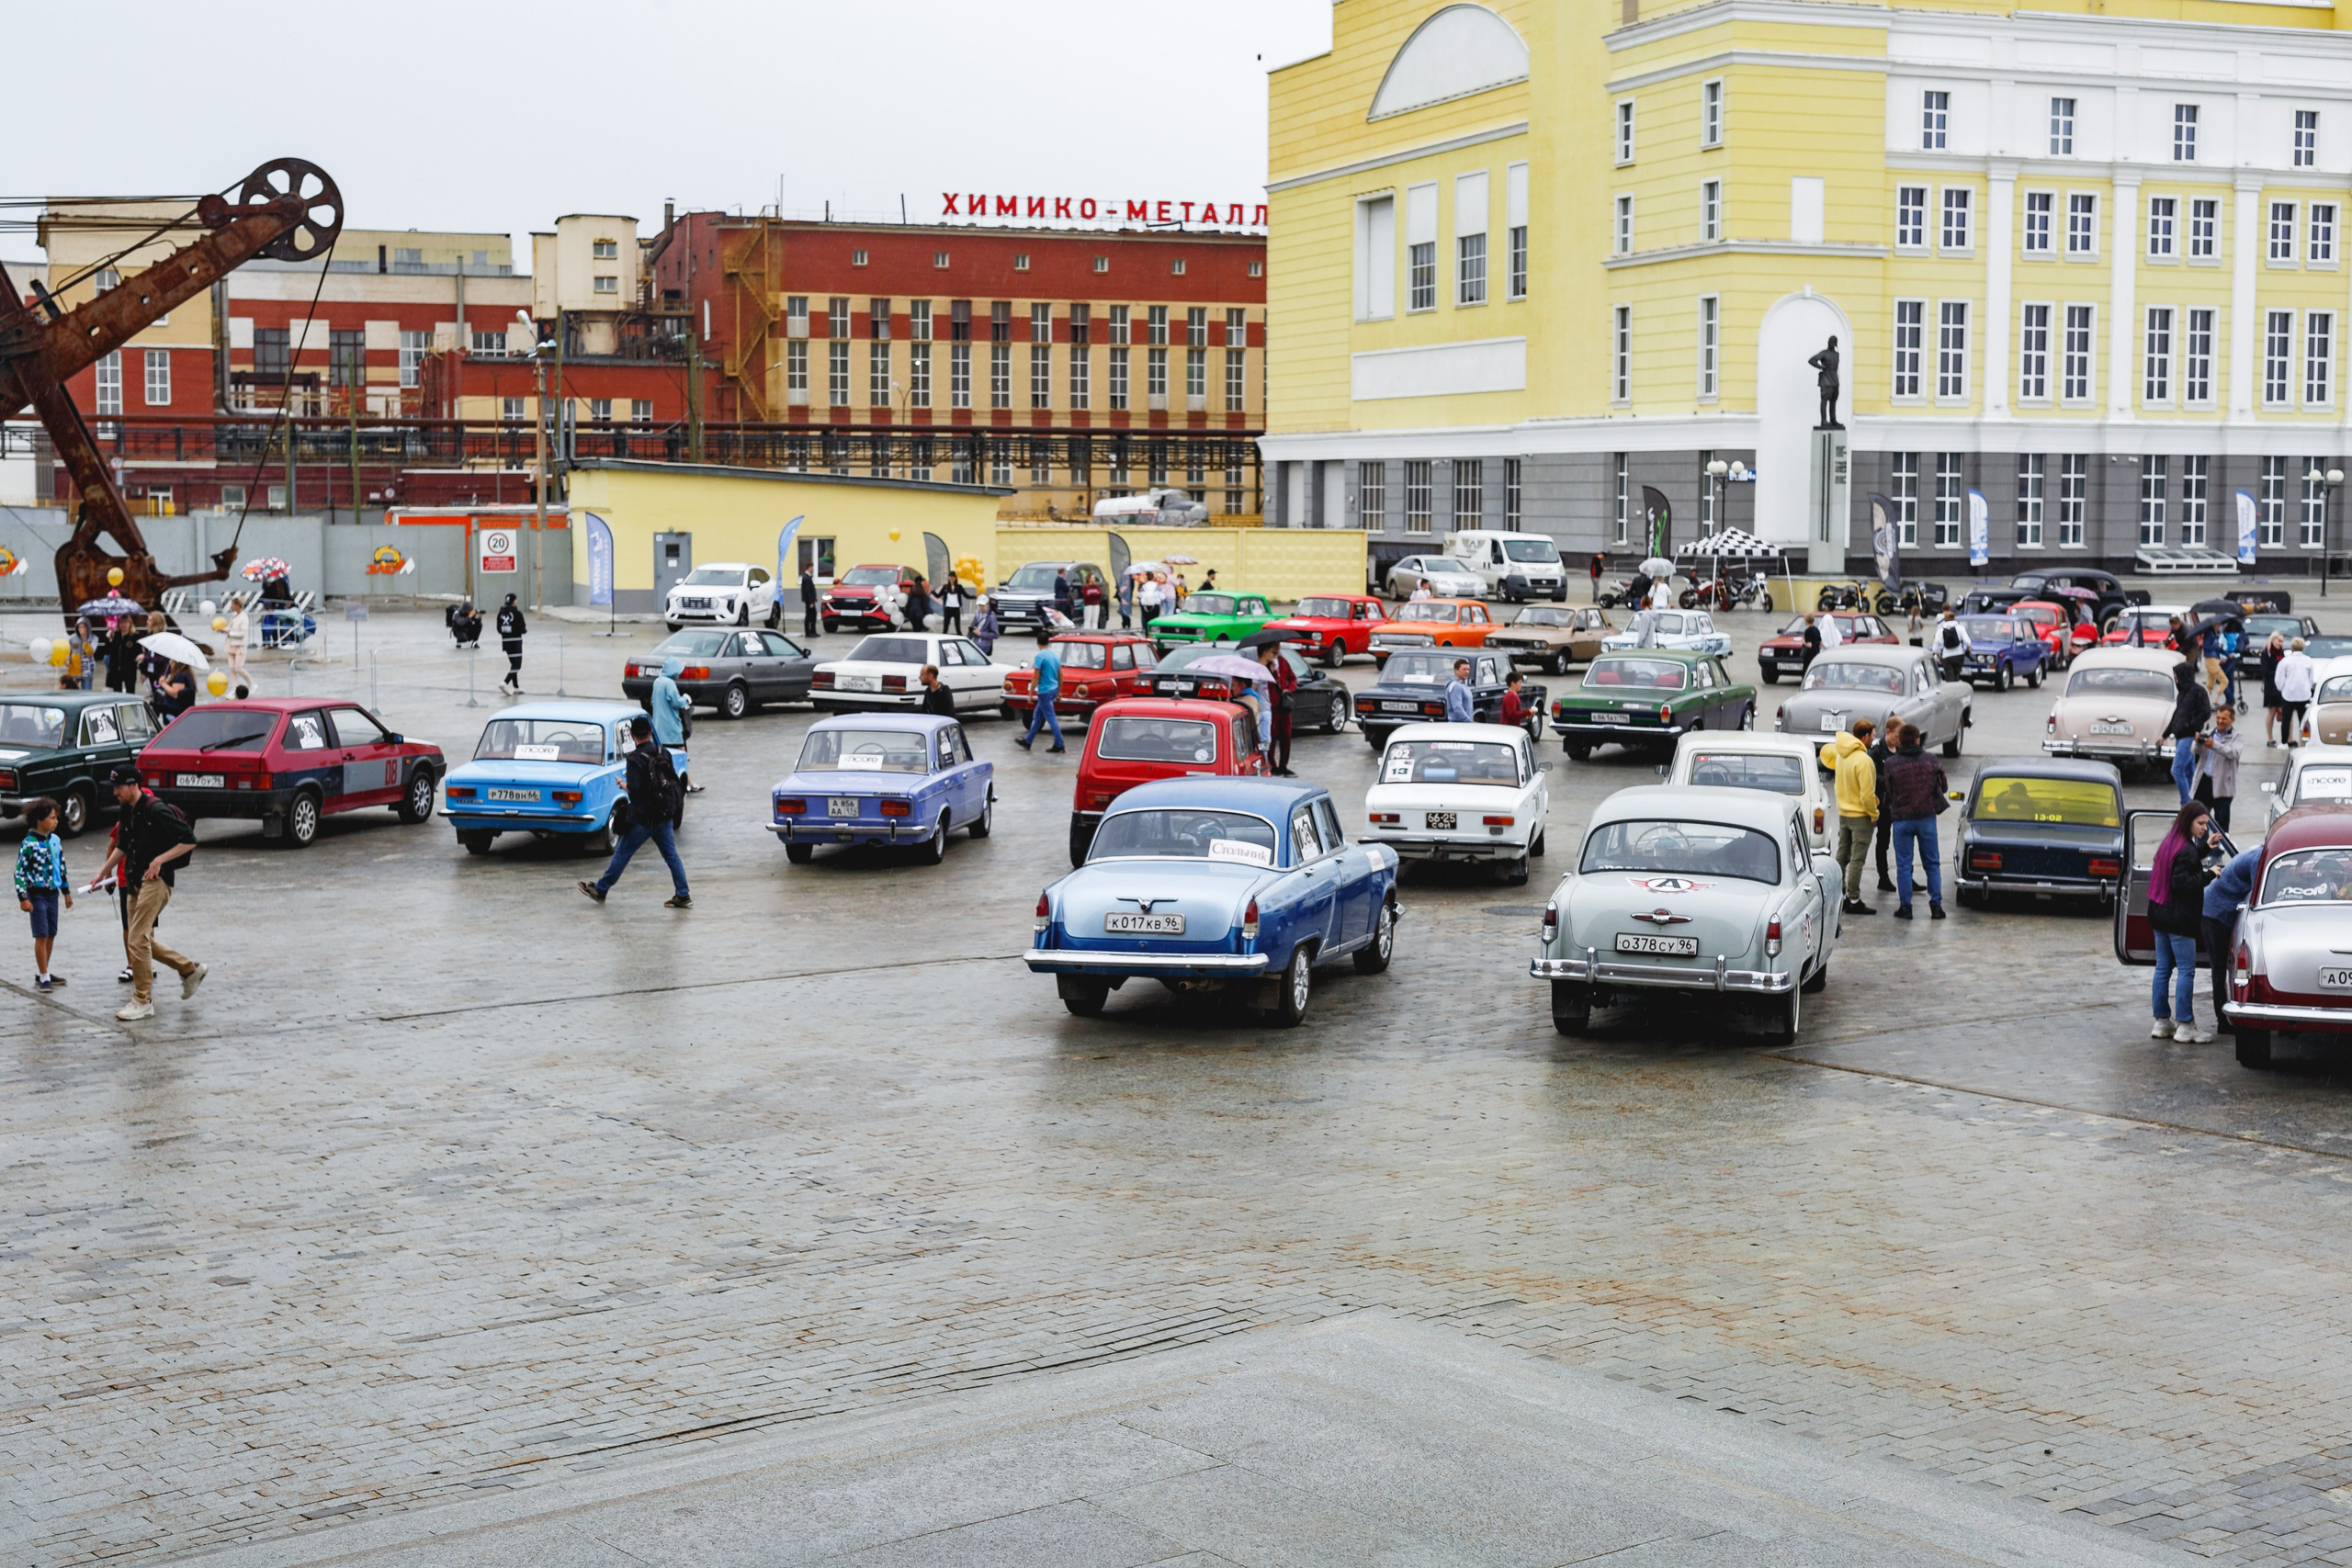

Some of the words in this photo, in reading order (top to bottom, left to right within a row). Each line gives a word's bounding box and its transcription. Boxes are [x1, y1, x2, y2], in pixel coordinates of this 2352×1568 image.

[492, 538, 505, 548] 20
[385, 760, 397, 786] 08
[491, 790, 526, 800] Р778ВН
[528, 790, 538, 799] 66
[1212, 842, 1268, 862] Стольник
[1112, 916, 1161, 931] К017КВ
[1165, 917, 1177, 928] 96
[1622, 937, 1675, 952] О378СУ
[1679, 939, 1692, 950] 96
